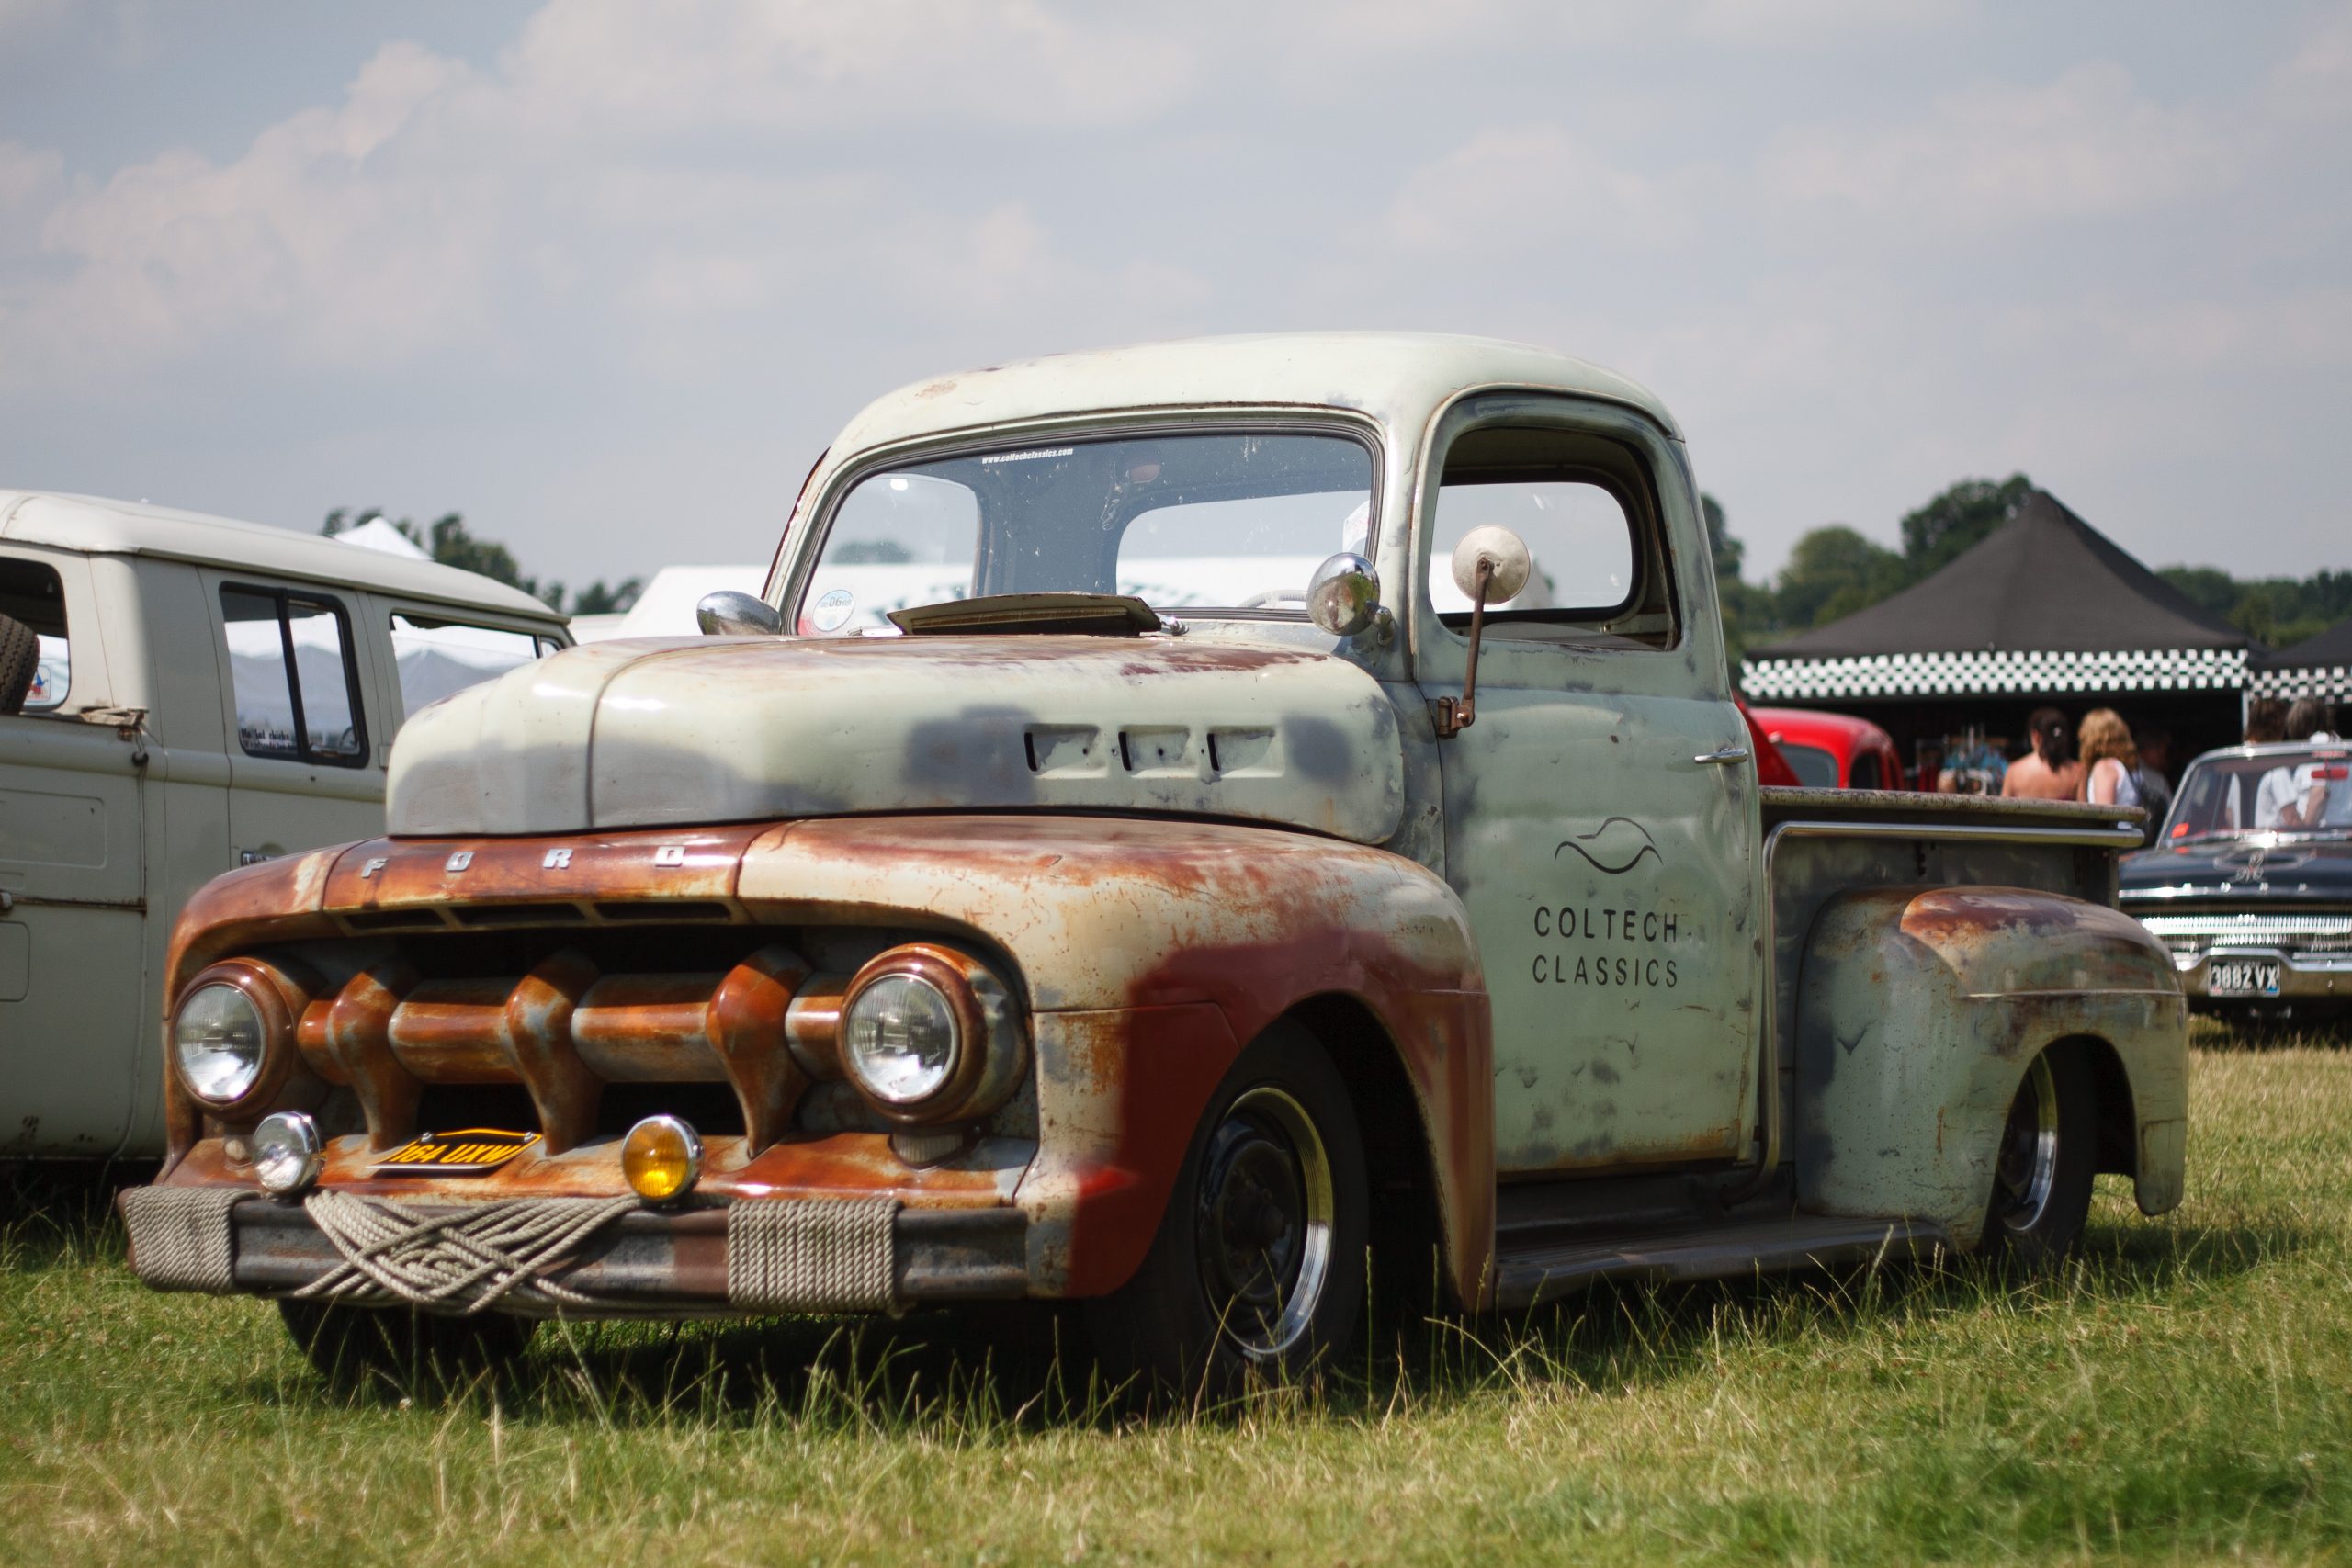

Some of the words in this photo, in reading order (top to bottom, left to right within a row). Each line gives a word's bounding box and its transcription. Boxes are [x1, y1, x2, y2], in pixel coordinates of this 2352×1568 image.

[981, 447, 1074, 465] www.coltechclassics.com
[361, 845, 686, 878] FORD
[1533, 905, 1678, 943] COLTECH
[1532, 954, 1678, 988] CLASSICS
[388, 1144, 449, 1164] 164
[438, 1144, 524, 1164] UXW
